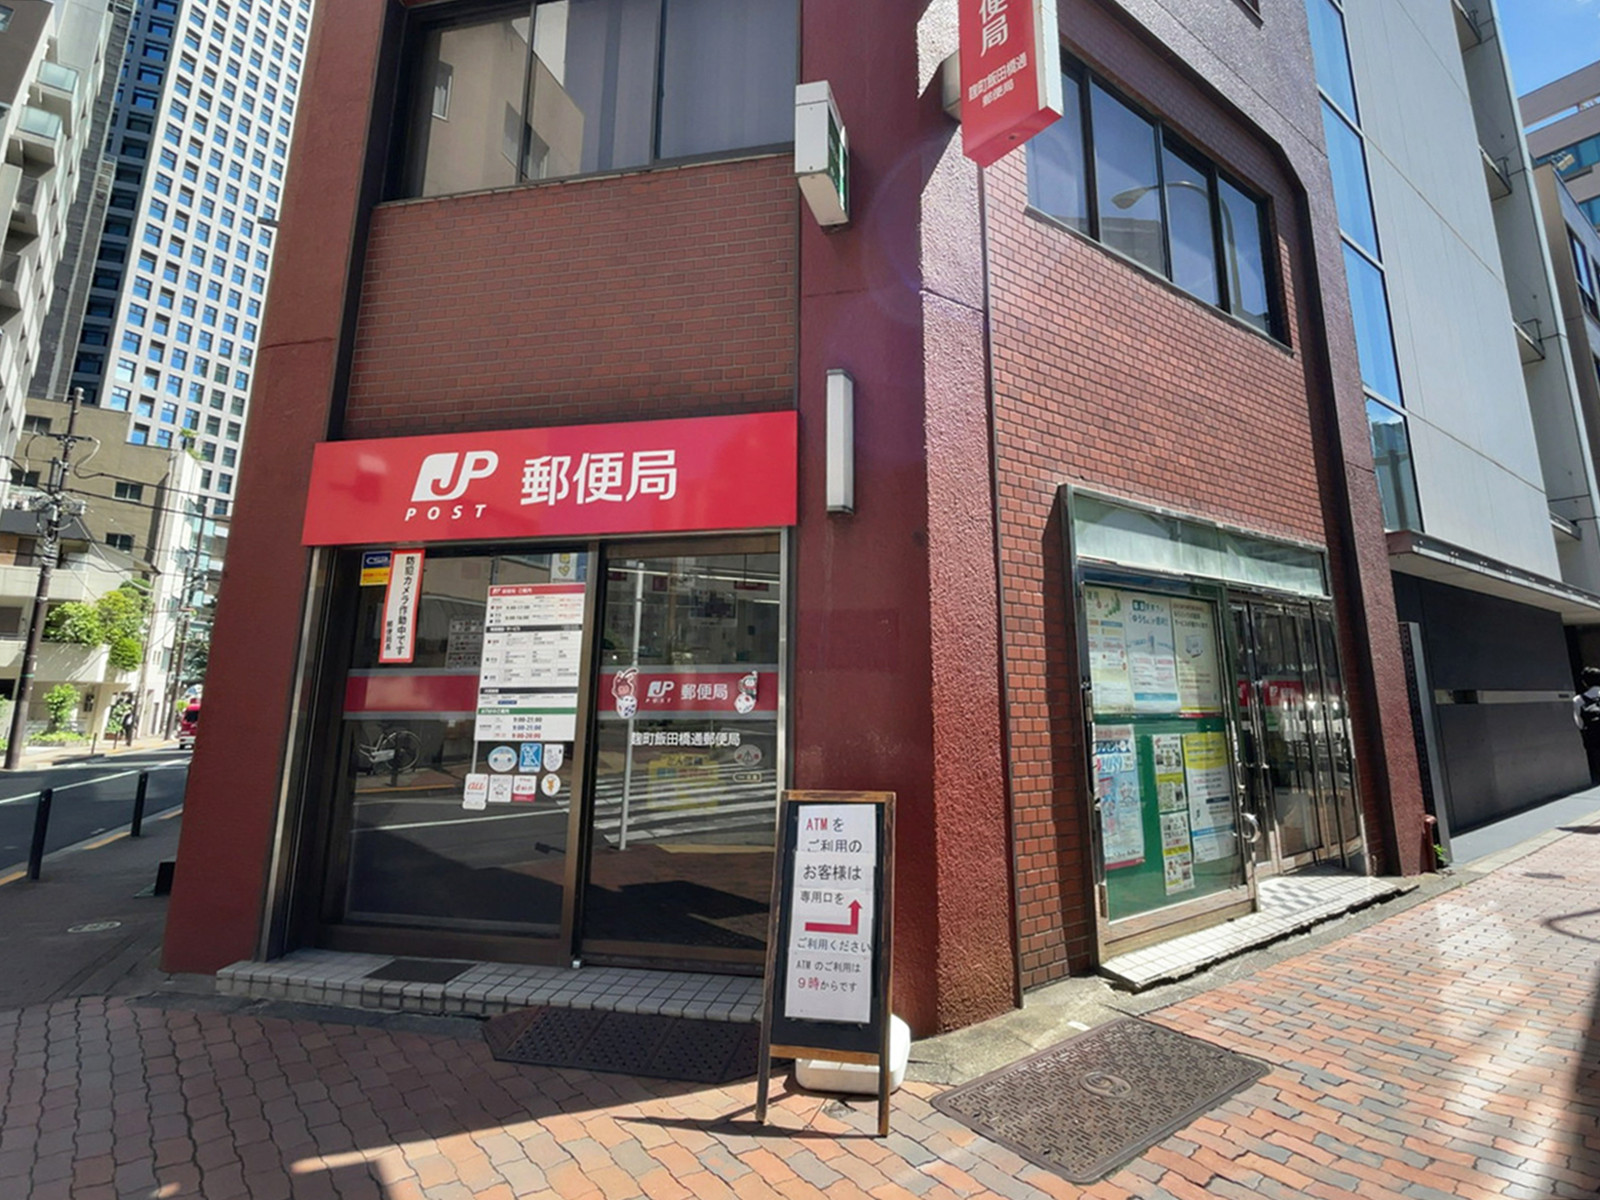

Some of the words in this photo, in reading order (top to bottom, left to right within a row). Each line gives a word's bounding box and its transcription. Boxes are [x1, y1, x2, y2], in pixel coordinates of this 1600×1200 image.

[411, 451, 499, 502] JP
[520, 450, 677, 506] 郵便局
[404, 504, 487, 522] POST
[396, 556, 415, 655] 防犯カメラ作動中です
[647, 680, 675, 697] JP
[681, 683, 729, 700] 郵便局
[631, 731, 740, 746] 麹町飯田橋通郵便局
[806, 839, 862, 853] ご利用の
[803, 864, 862, 880] お客様は
[800, 890, 845, 905] 専用口を
[797, 937, 873, 953] ご利用ください
[798, 976, 857, 992] 9時からです
